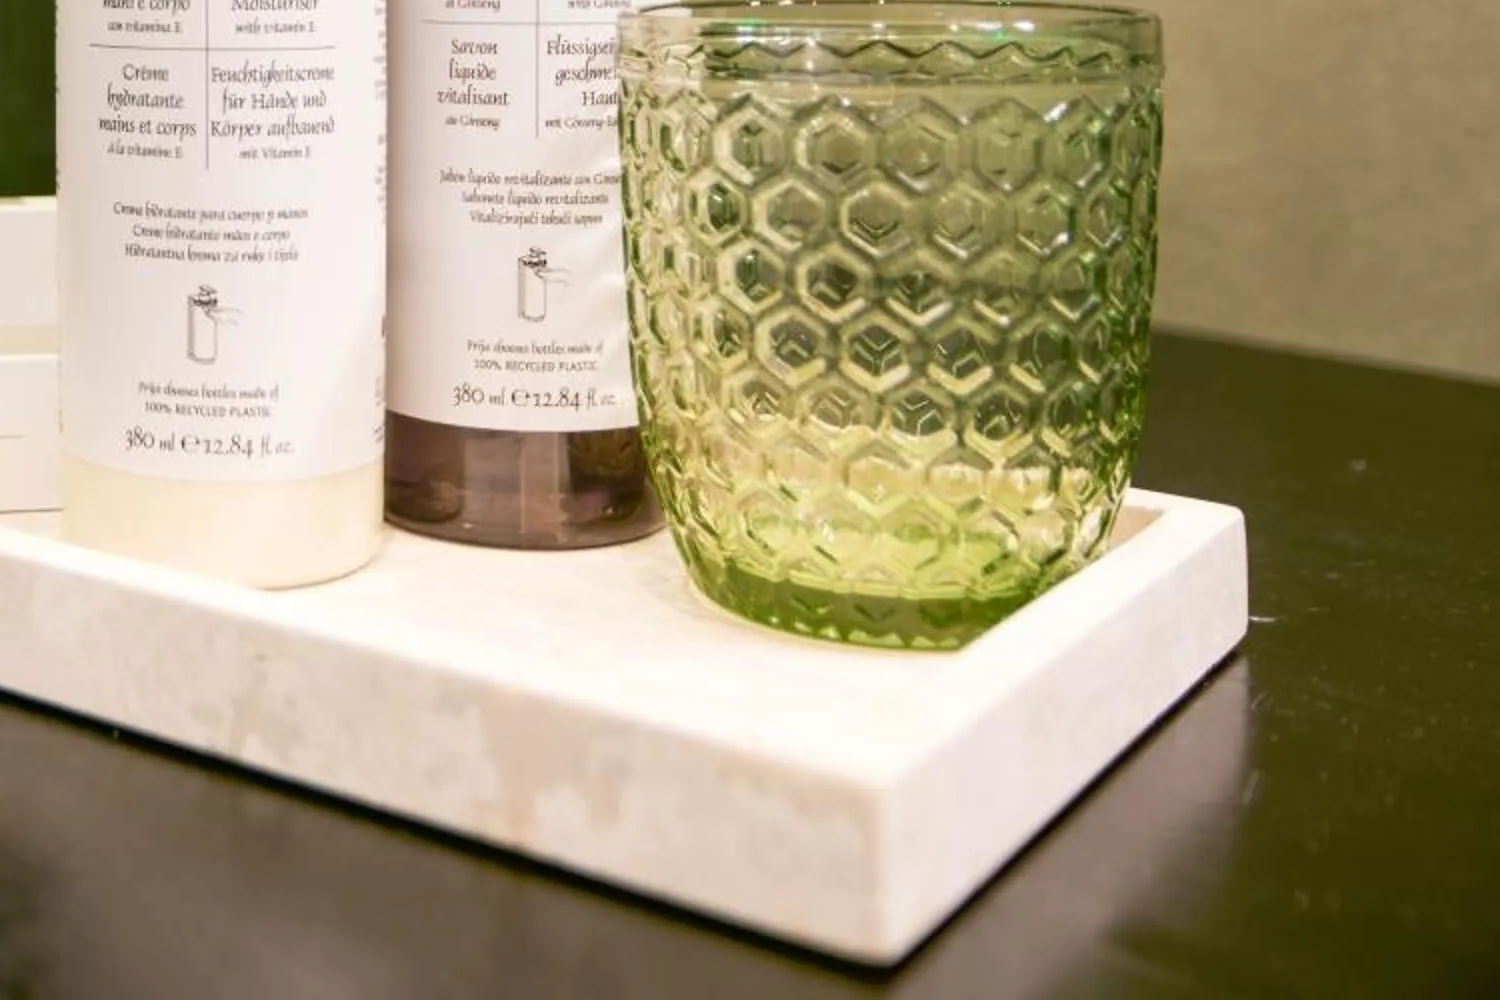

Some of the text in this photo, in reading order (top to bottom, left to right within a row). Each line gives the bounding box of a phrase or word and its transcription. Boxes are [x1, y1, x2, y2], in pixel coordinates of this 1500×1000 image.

[451, 38, 498, 55] Savon
[547, 33, 617, 58] Flüssigsei
[449, 57, 497, 85] liquide
[107, 82, 185, 112] hydratante
[222, 87, 246, 115] für
[303, 88, 328, 108] und
[437, 83, 510, 106] vitalisant
[99, 113, 197, 142] mains et corps
[211, 113, 335, 142] Körper aufbauend
[452, 383, 484, 406] 380
[489, 386, 506, 405] ml
[533, 387, 581, 412] 12.84
[125, 426, 155, 450] 380
[159, 431, 175, 452] ml
[204, 433, 254, 460] 12.84
